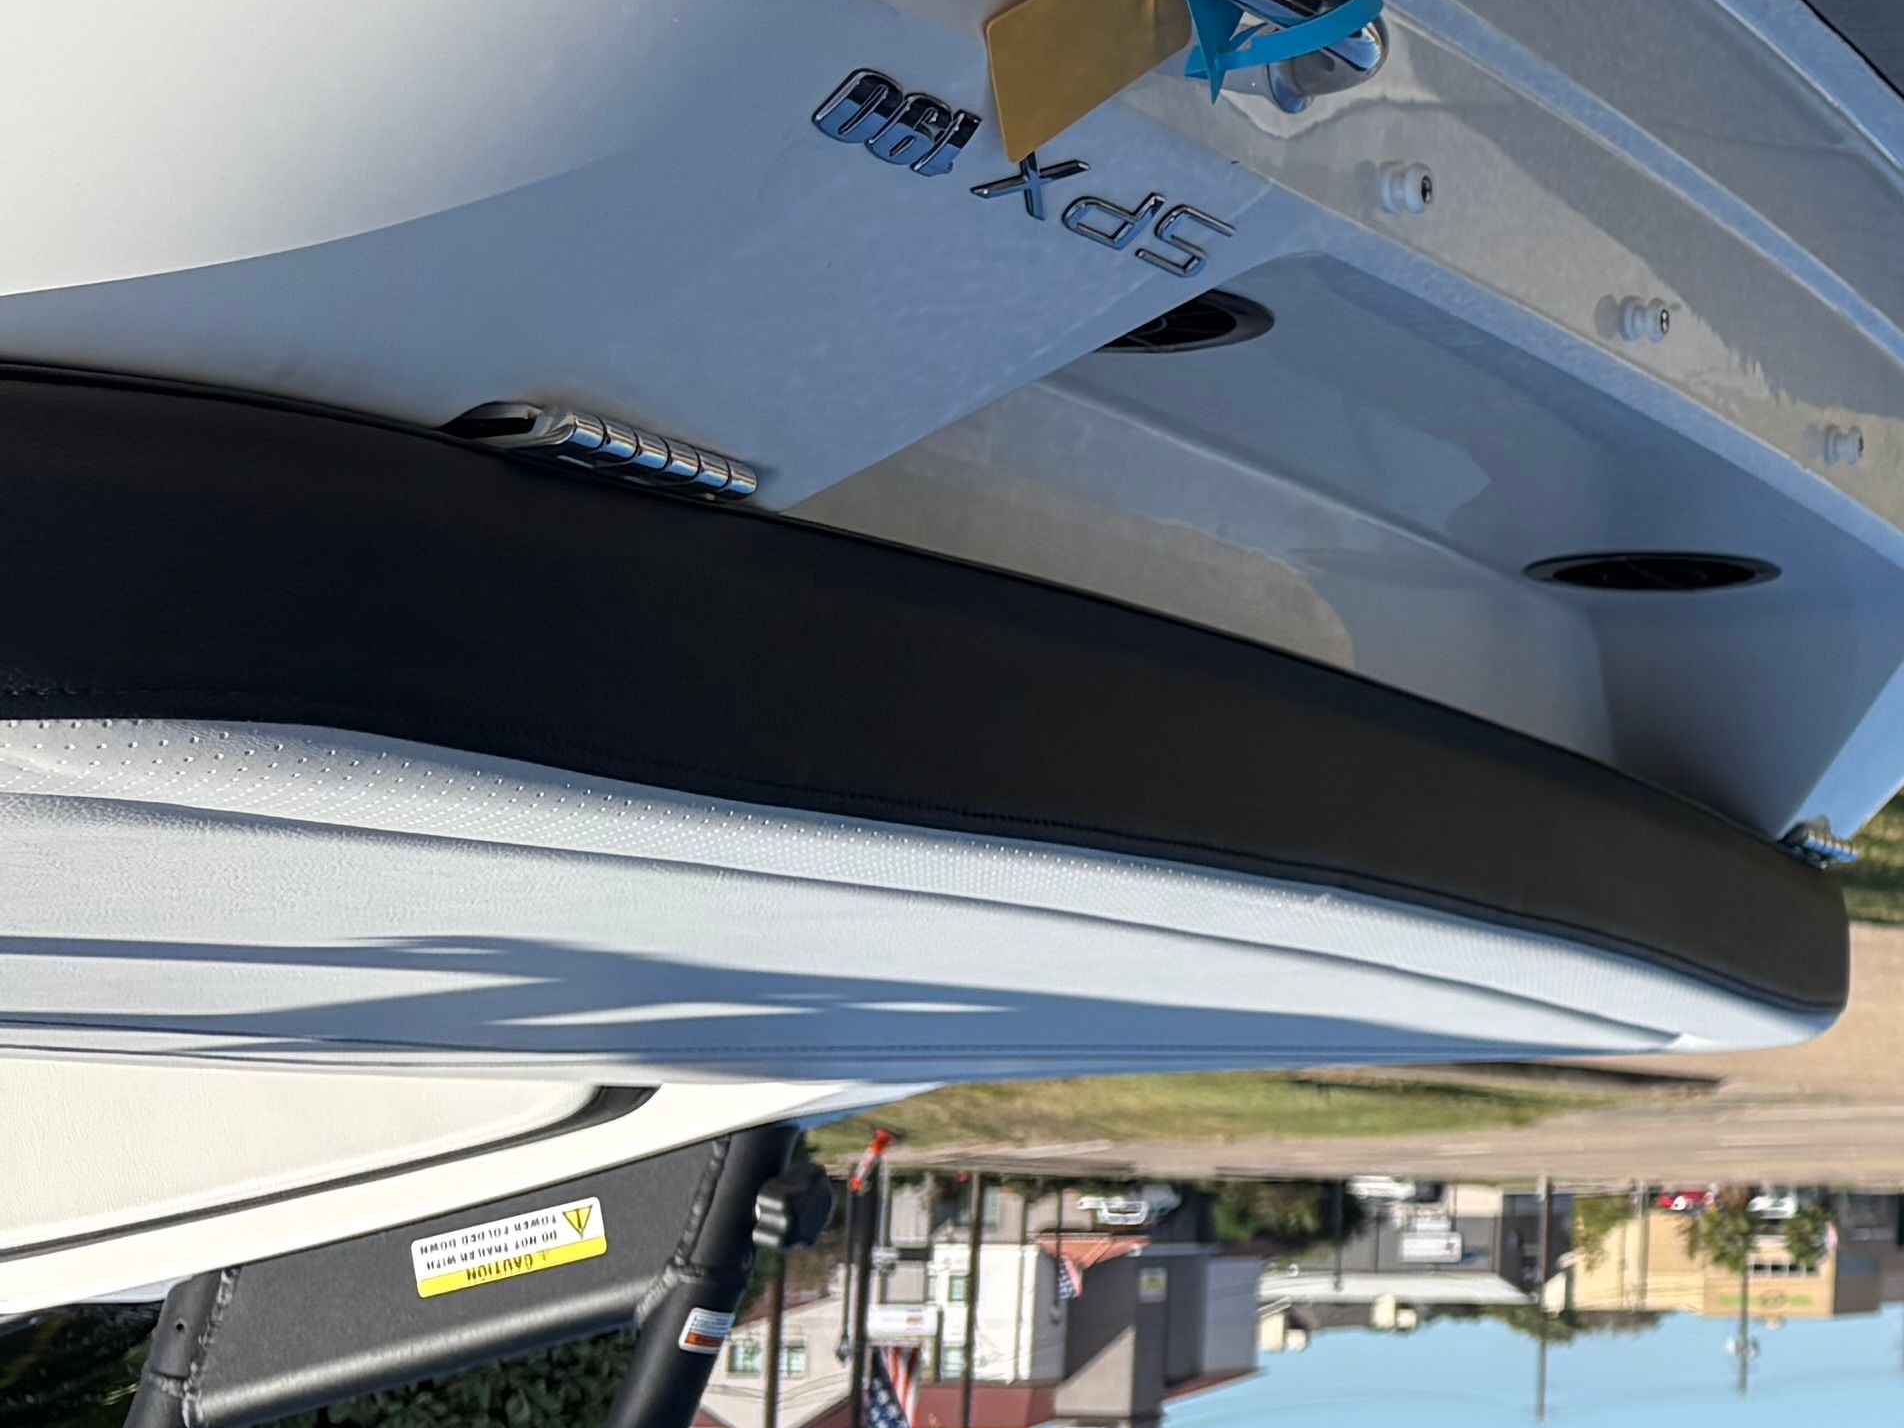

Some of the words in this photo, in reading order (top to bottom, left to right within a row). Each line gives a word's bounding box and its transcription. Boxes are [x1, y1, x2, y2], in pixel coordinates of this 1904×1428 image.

[811, 67, 983, 179] 190
[969, 151, 1237, 279] SPX
[420, 1239, 456, 1255] DOWN
[514, 1236, 537, 1250] NOT
[541, 1230, 557, 1242] DO
[465, 1253, 533, 1282] CAUTION
